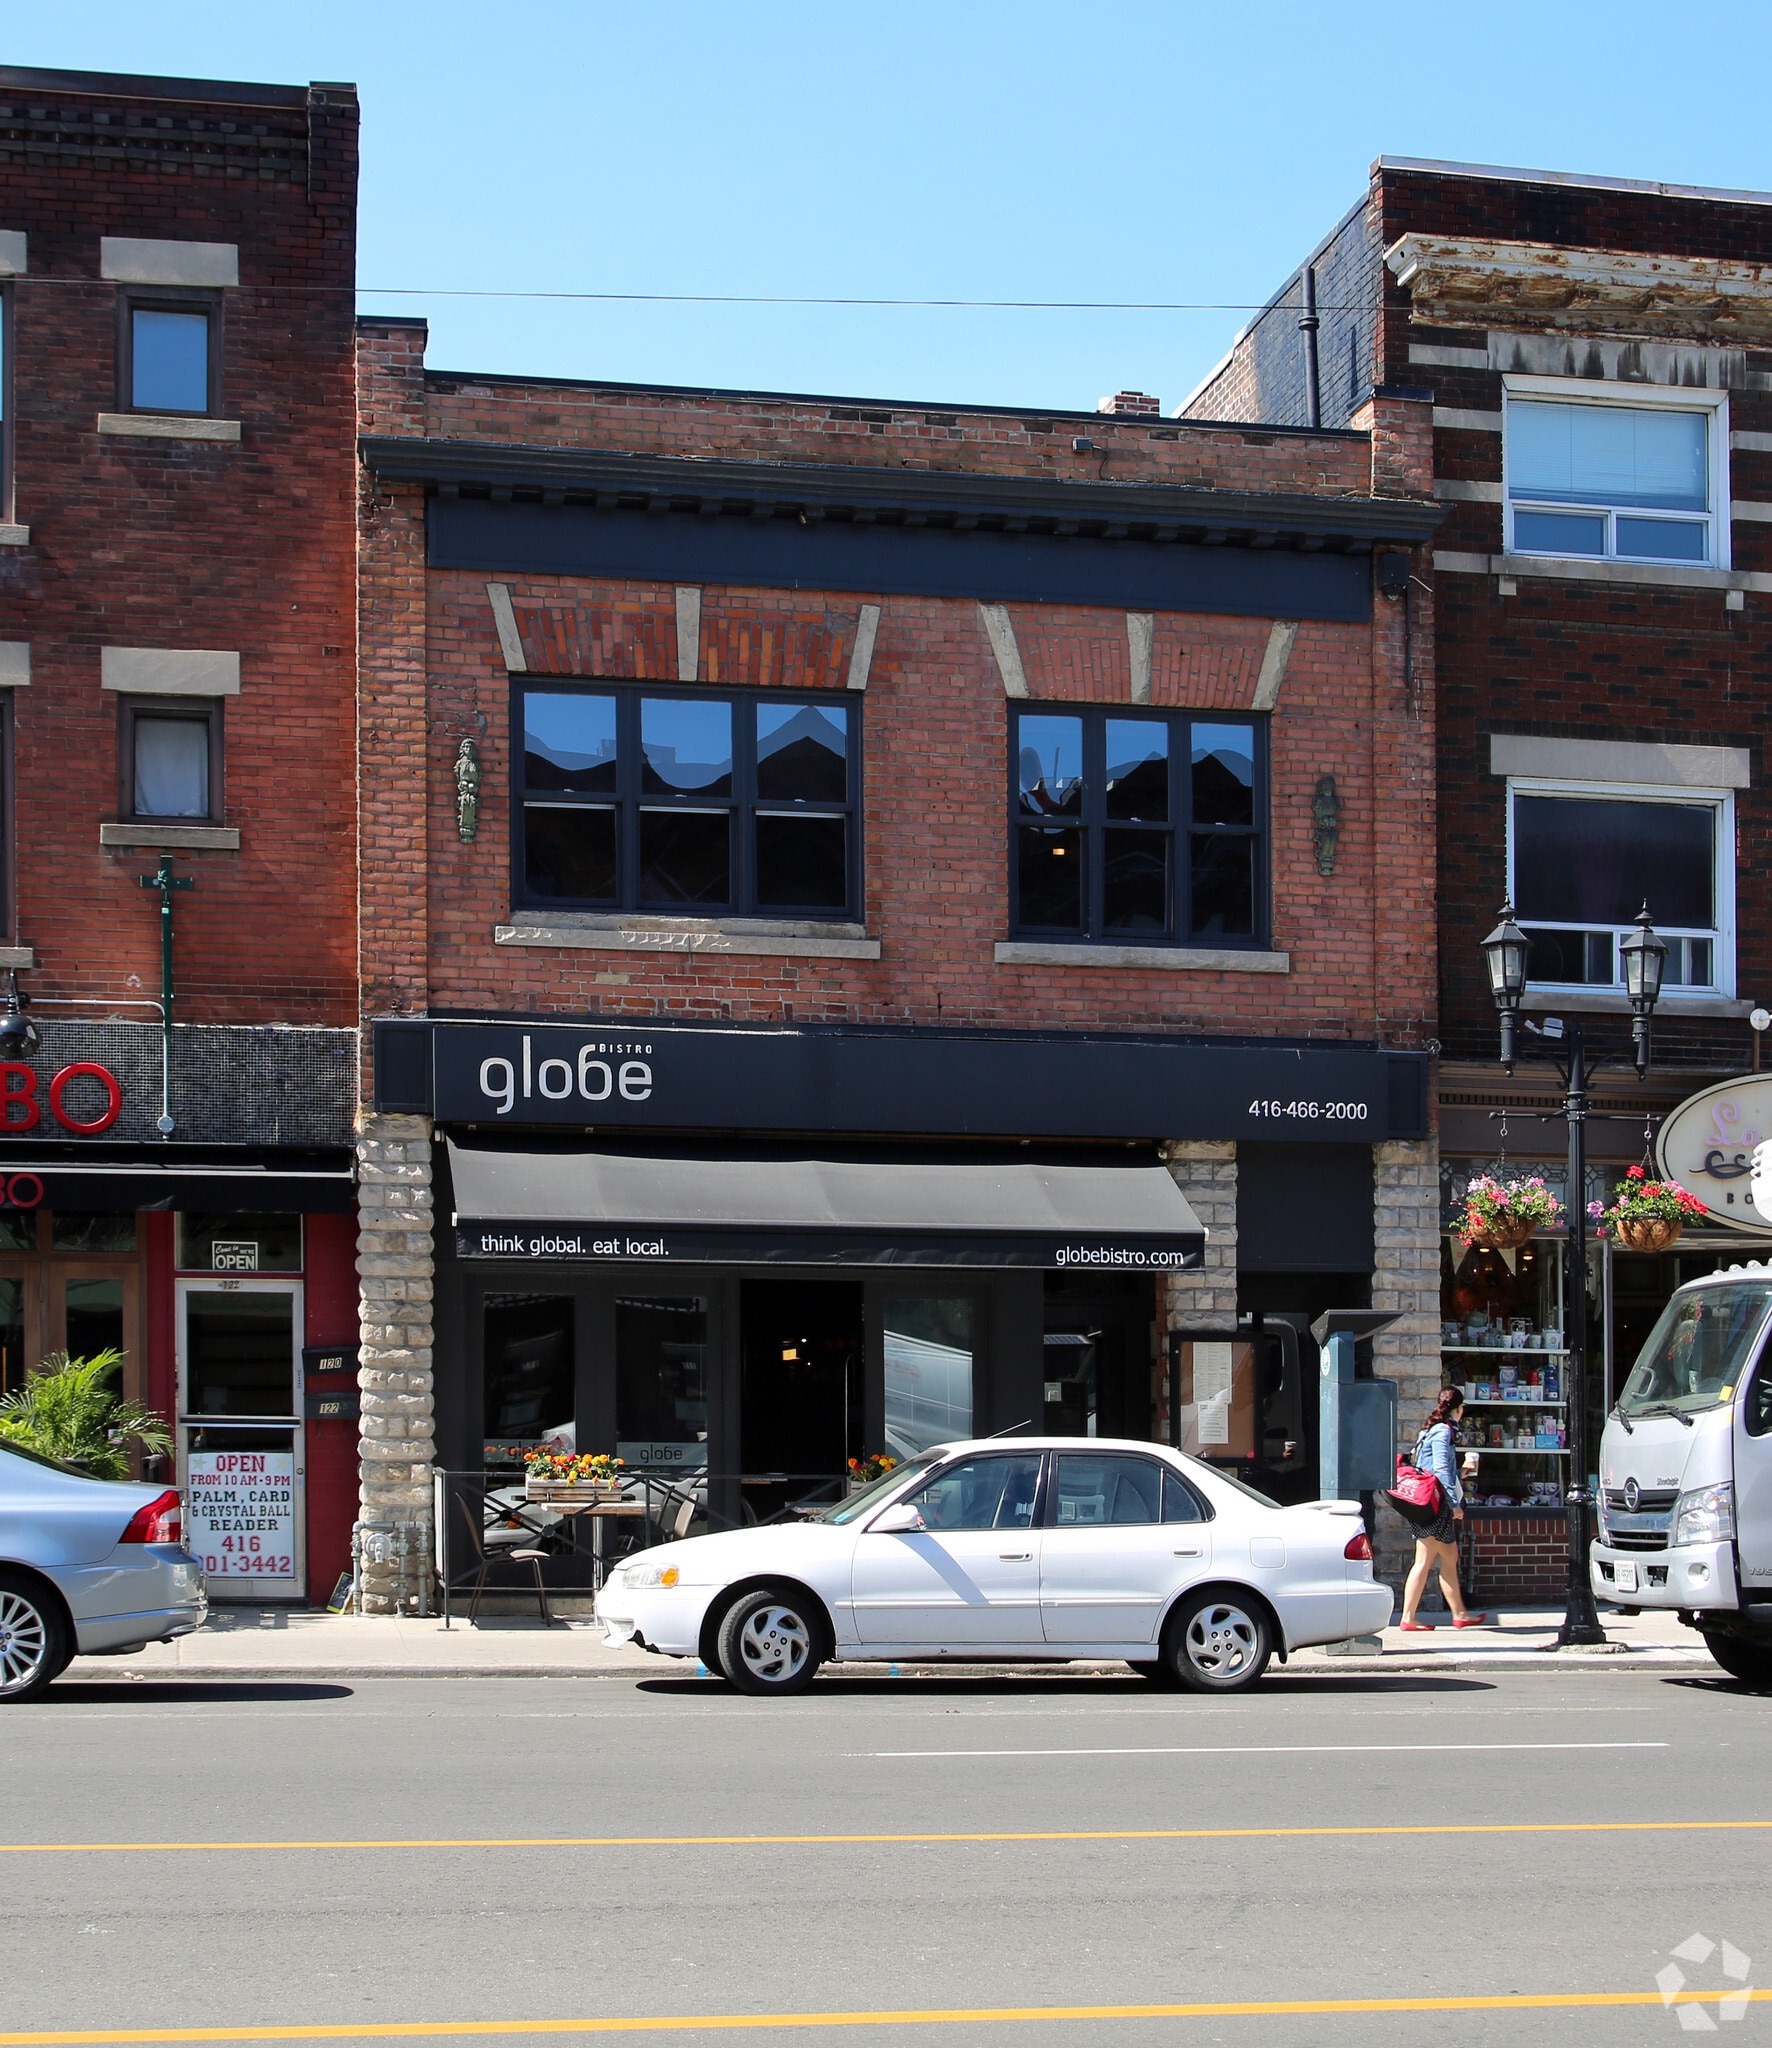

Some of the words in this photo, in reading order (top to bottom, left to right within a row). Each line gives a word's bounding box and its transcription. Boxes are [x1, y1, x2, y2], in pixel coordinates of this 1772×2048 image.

[599, 1043, 653, 1054] BISTRO
[479, 1035, 652, 1114] globe
[1248, 1100, 1368, 1119] 416-466-2000
[481, 1235, 525, 1252] think
[529, 1236, 586, 1256] global.
[592, 1238, 621, 1254] eat
[626, 1238, 669, 1255] local.
[215, 1254, 255, 1270] OPEN
[1055, 1246, 1184, 1266] globebistro.com
[320, 1358, 341, 1368] 120
[321, 1403, 338, 1413] 122
[640, 1443, 683, 1463] globe
[216, 1455, 265, 1472] OPEN
[190, 1474, 221, 1485] FROM
[225, 1475, 237, 1485] 10
[274, 1475, 290, 1486] PM
[249, 1491, 290, 1502] CARD
[192, 1506, 198, 1517] &
[202, 1505, 256, 1516] CRYSTAL
[260, 1506, 290, 1516] BALL
[209, 1519, 278, 1530] READER
[222, 1535, 260, 1552] 416
[199, 1555, 290, 1572] 01-3442
